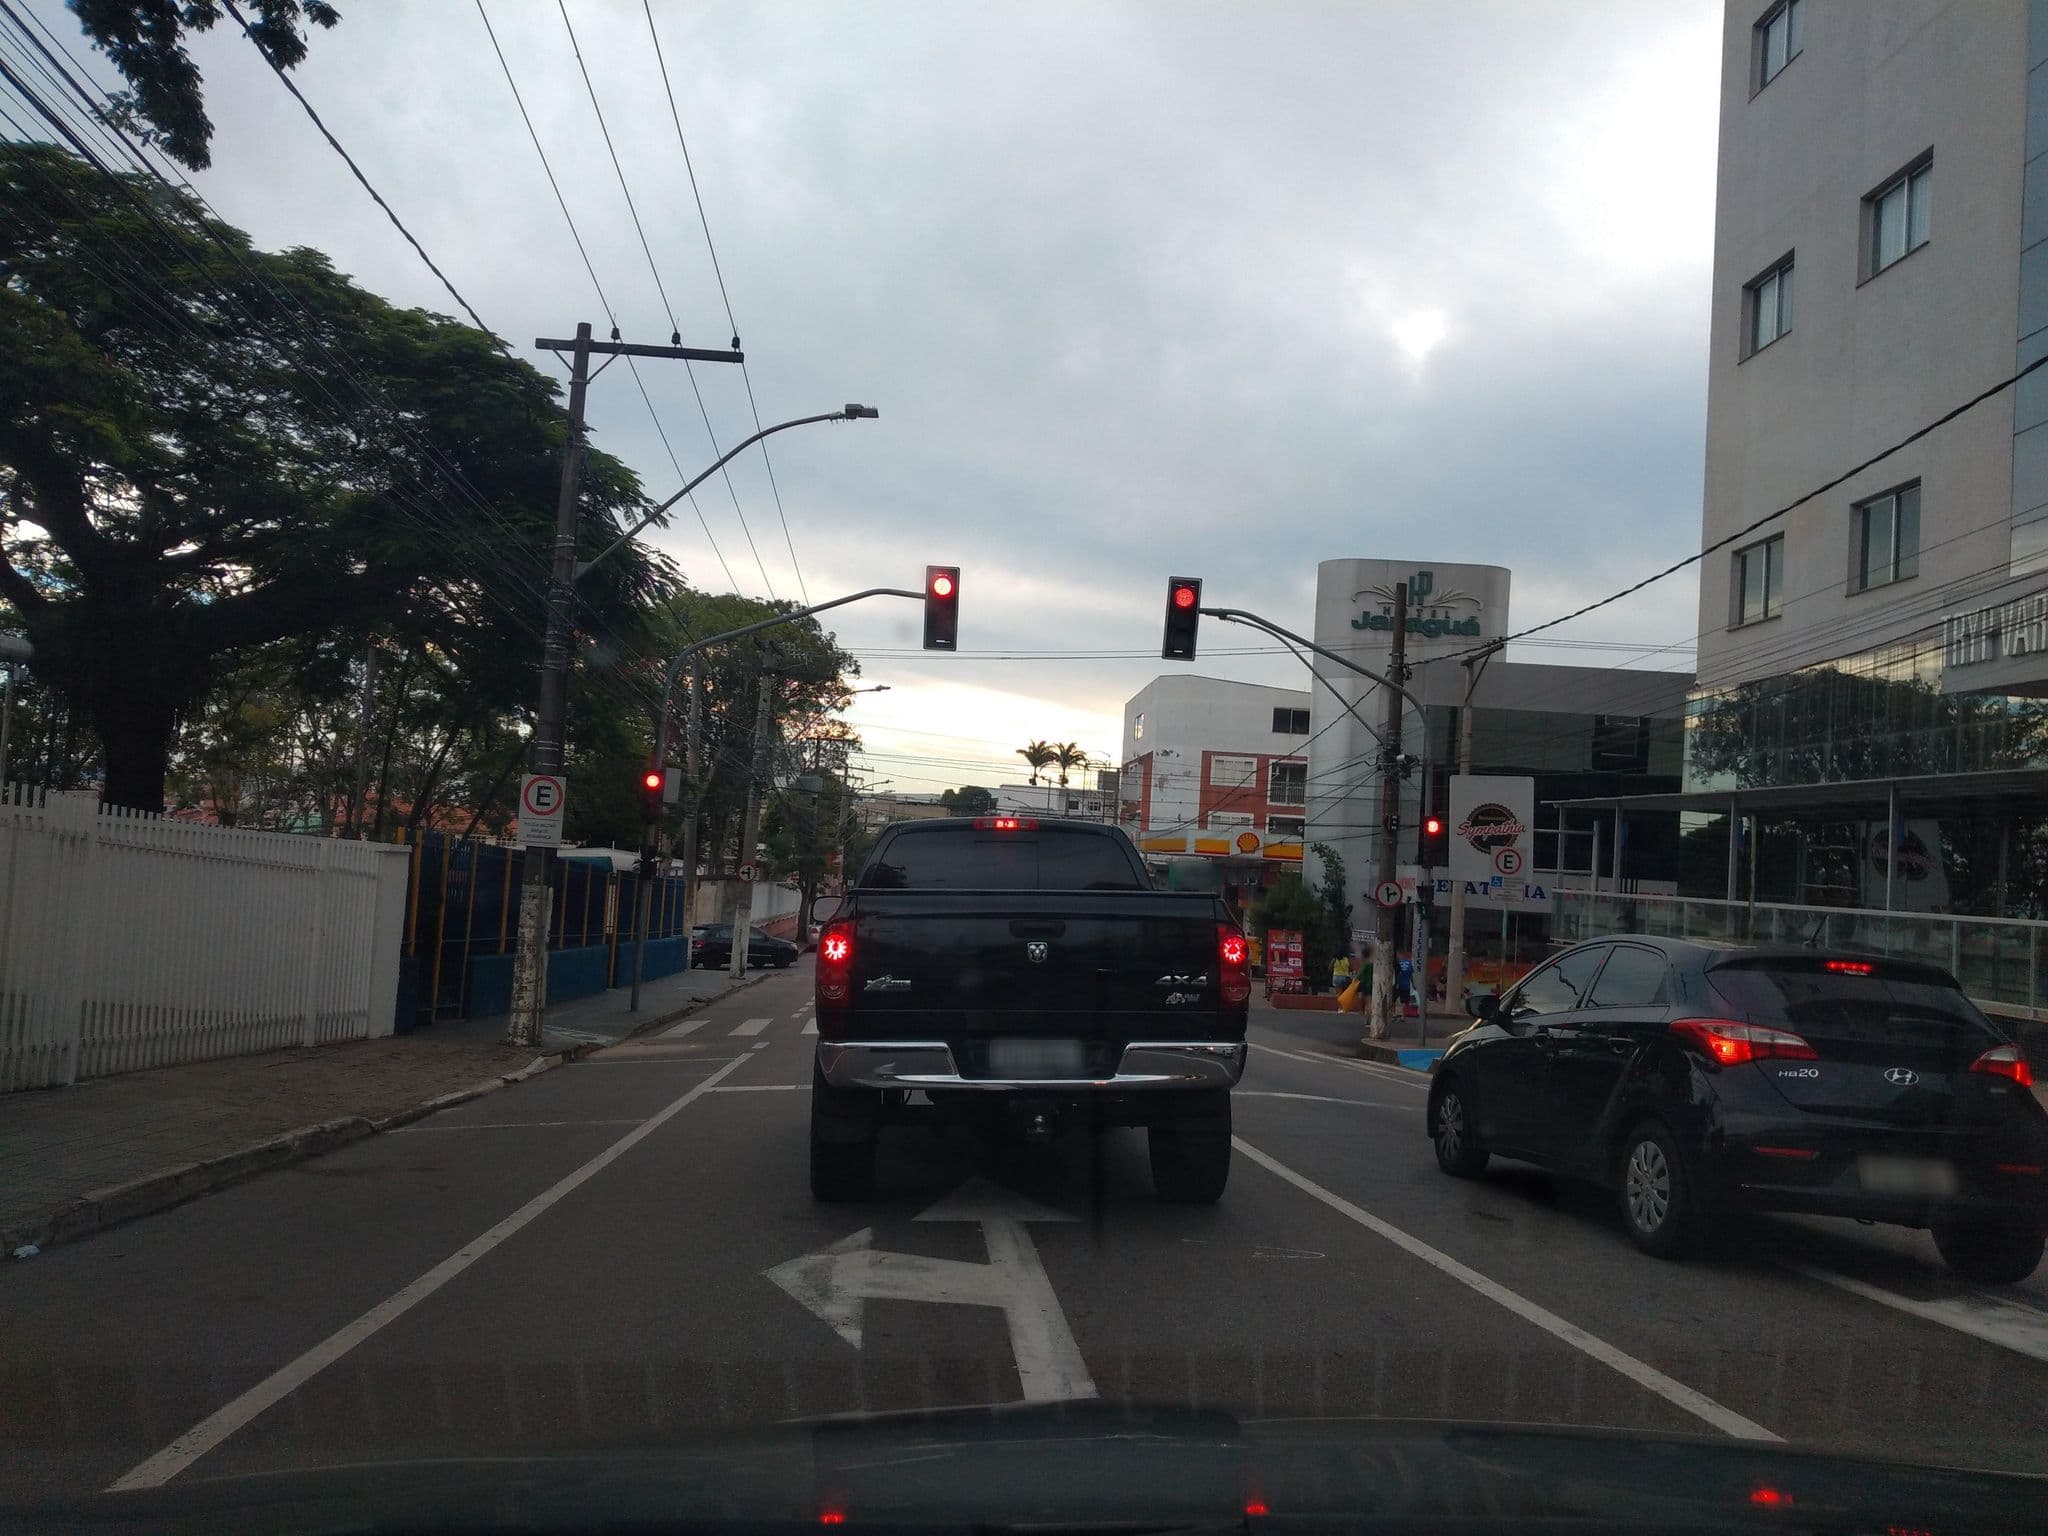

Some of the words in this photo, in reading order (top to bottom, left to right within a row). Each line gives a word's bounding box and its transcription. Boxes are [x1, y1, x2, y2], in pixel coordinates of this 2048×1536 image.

[1382, 606, 1450, 619] HTEL
[536, 785, 551, 806] E
[1503, 855, 1513, 869] E
[1778, 1068, 1819, 1078] HB20
